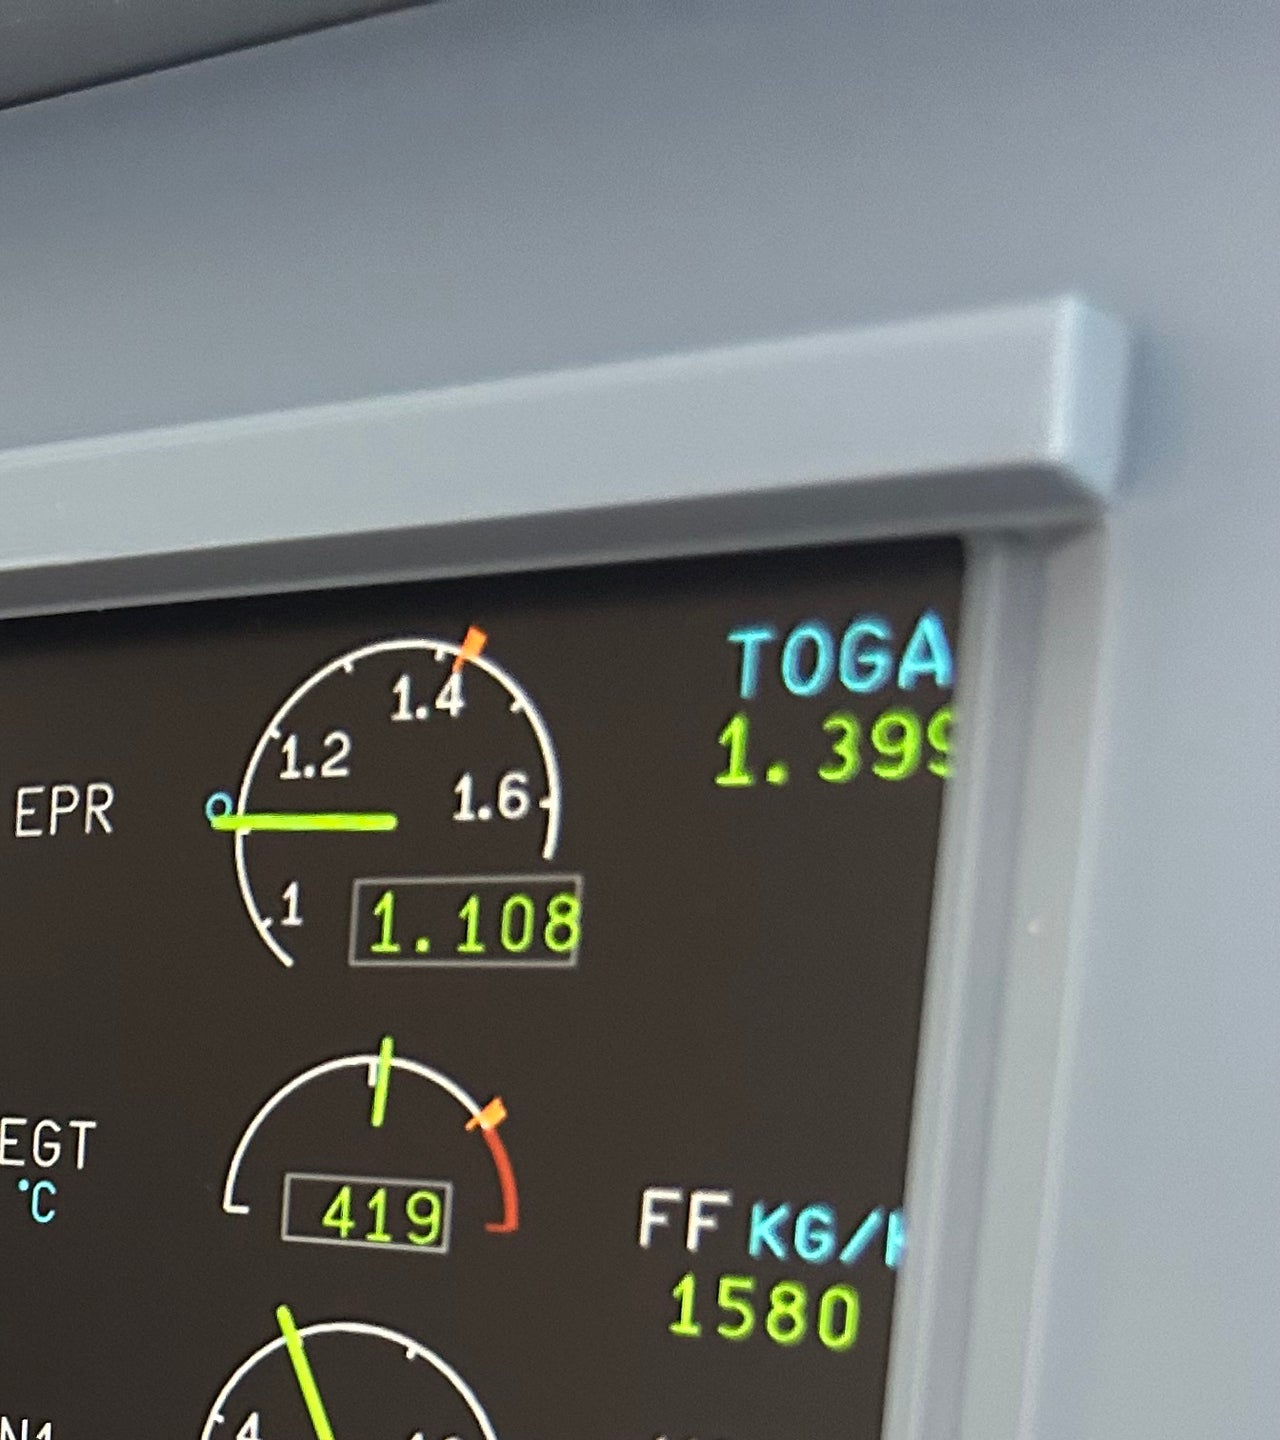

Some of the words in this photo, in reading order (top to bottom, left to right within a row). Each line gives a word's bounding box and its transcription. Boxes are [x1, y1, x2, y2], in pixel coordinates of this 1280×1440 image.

[727, 610, 955, 698] TOGA
[391, 674, 465, 720] 1.4
[280, 731, 351, 779] 1.2
[16, 783, 114, 836] EPR
[453, 773, 529, 822] 1.6
[282, 882, 303, 925] 1
[370, 891, 580, 952] 1.108
[322, 1186, 440, 1244] 419
[639, 1186, 732, 1252] FF
[669, 1271, 860, 1350] 1580
